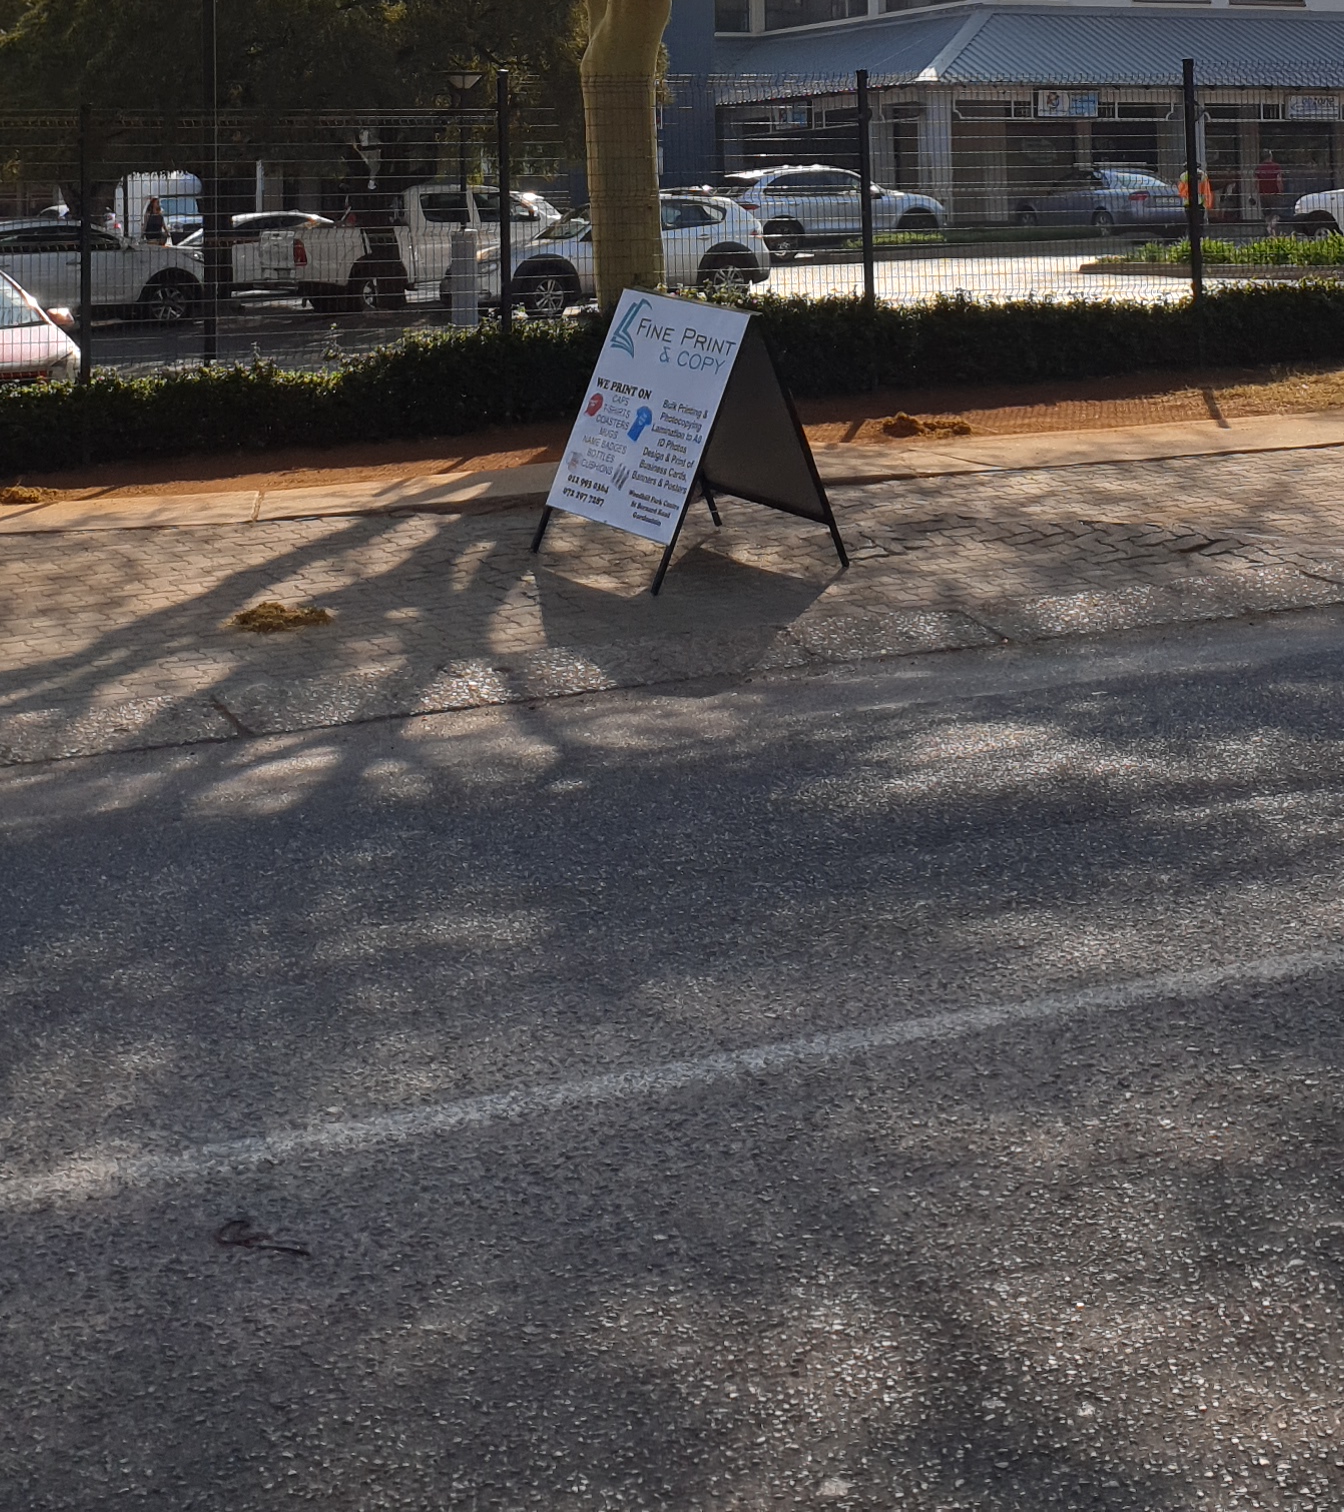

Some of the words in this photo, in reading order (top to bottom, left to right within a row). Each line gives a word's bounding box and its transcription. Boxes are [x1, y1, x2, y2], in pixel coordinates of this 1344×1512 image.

[636, 317, 675, 343] FINE
[680, 327, 737, 356] PRINT
[659, 346, 671, 363] &
[677, 351, 726, 375] COPY
[596, 377, 610, 389] WE
[610, 381, 638, 396] PRINT
[638, 388, 652, 400] ON
[596, 413, 629, 430] COASTERS
[660, 412, 702, 433] Photocopying
